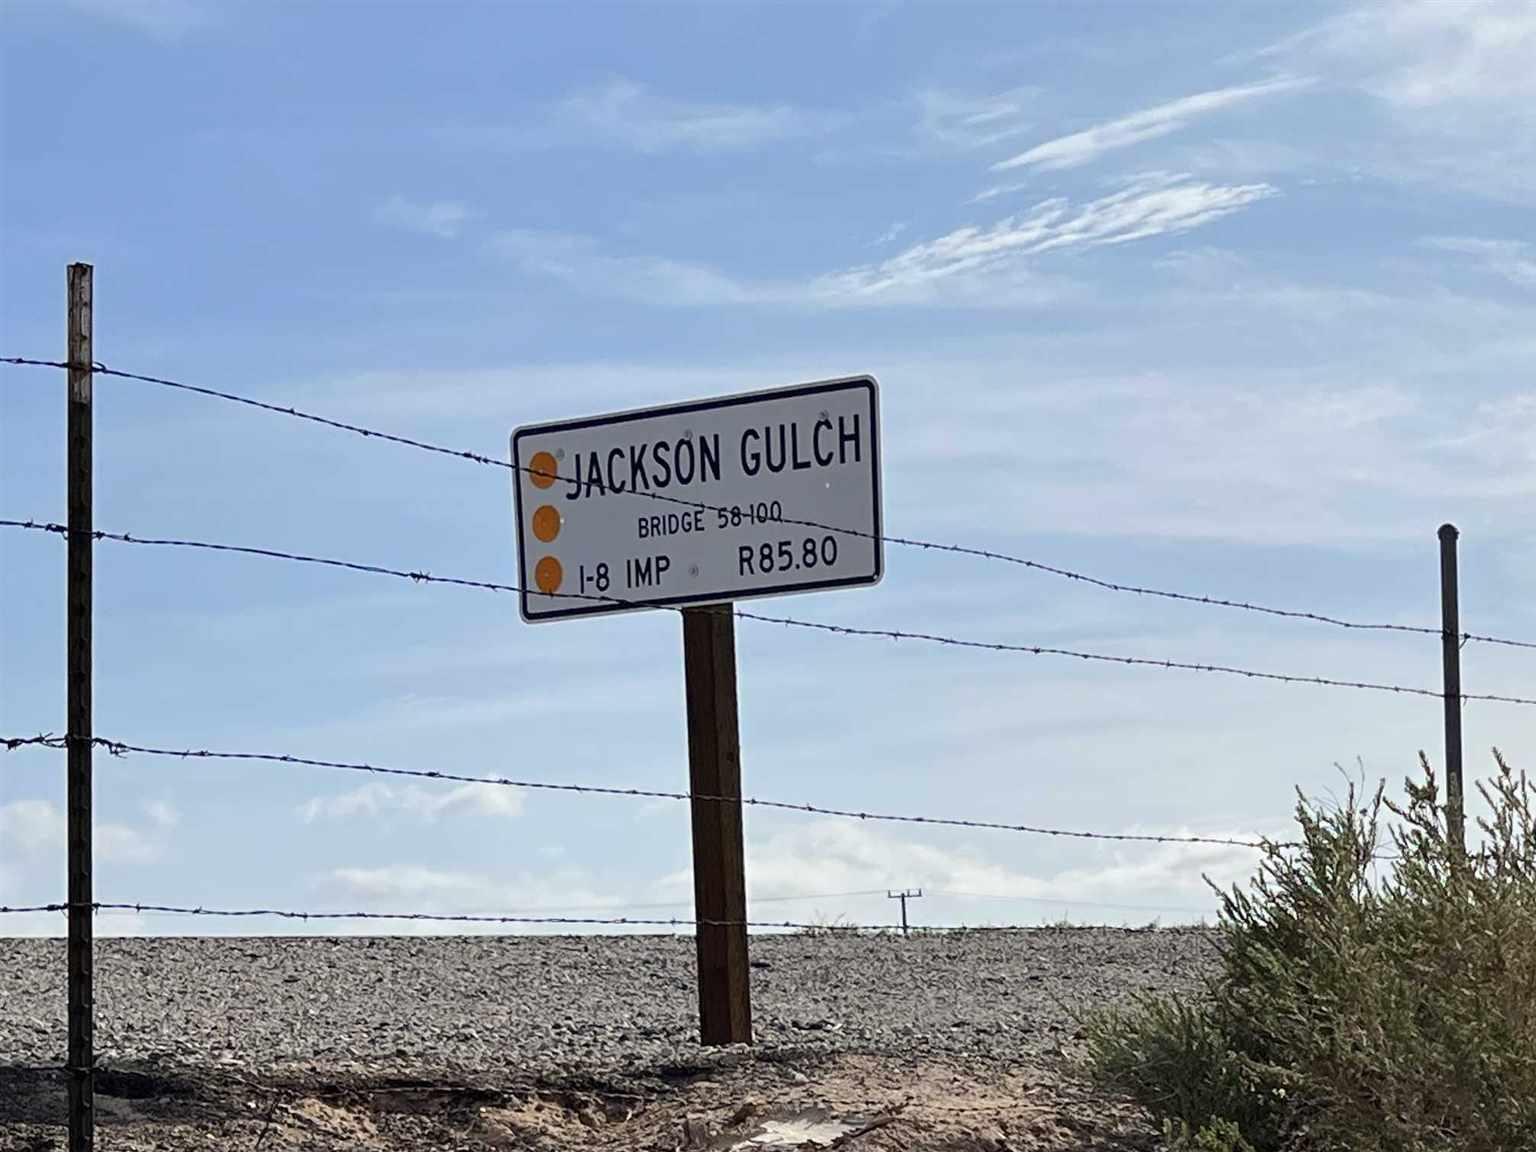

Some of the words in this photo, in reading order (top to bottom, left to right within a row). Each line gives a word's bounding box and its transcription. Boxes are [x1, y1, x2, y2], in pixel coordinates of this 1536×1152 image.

[566, 434, 721, 500] JACKSON
[741, 414, 862, 476] GULCH
[638, 509, 705, 538] BRIDGE
[580, 563, 609, 594] I-8
[626, 555, 671, 588] IMP
[739, 535, 837, 576] R85.80
